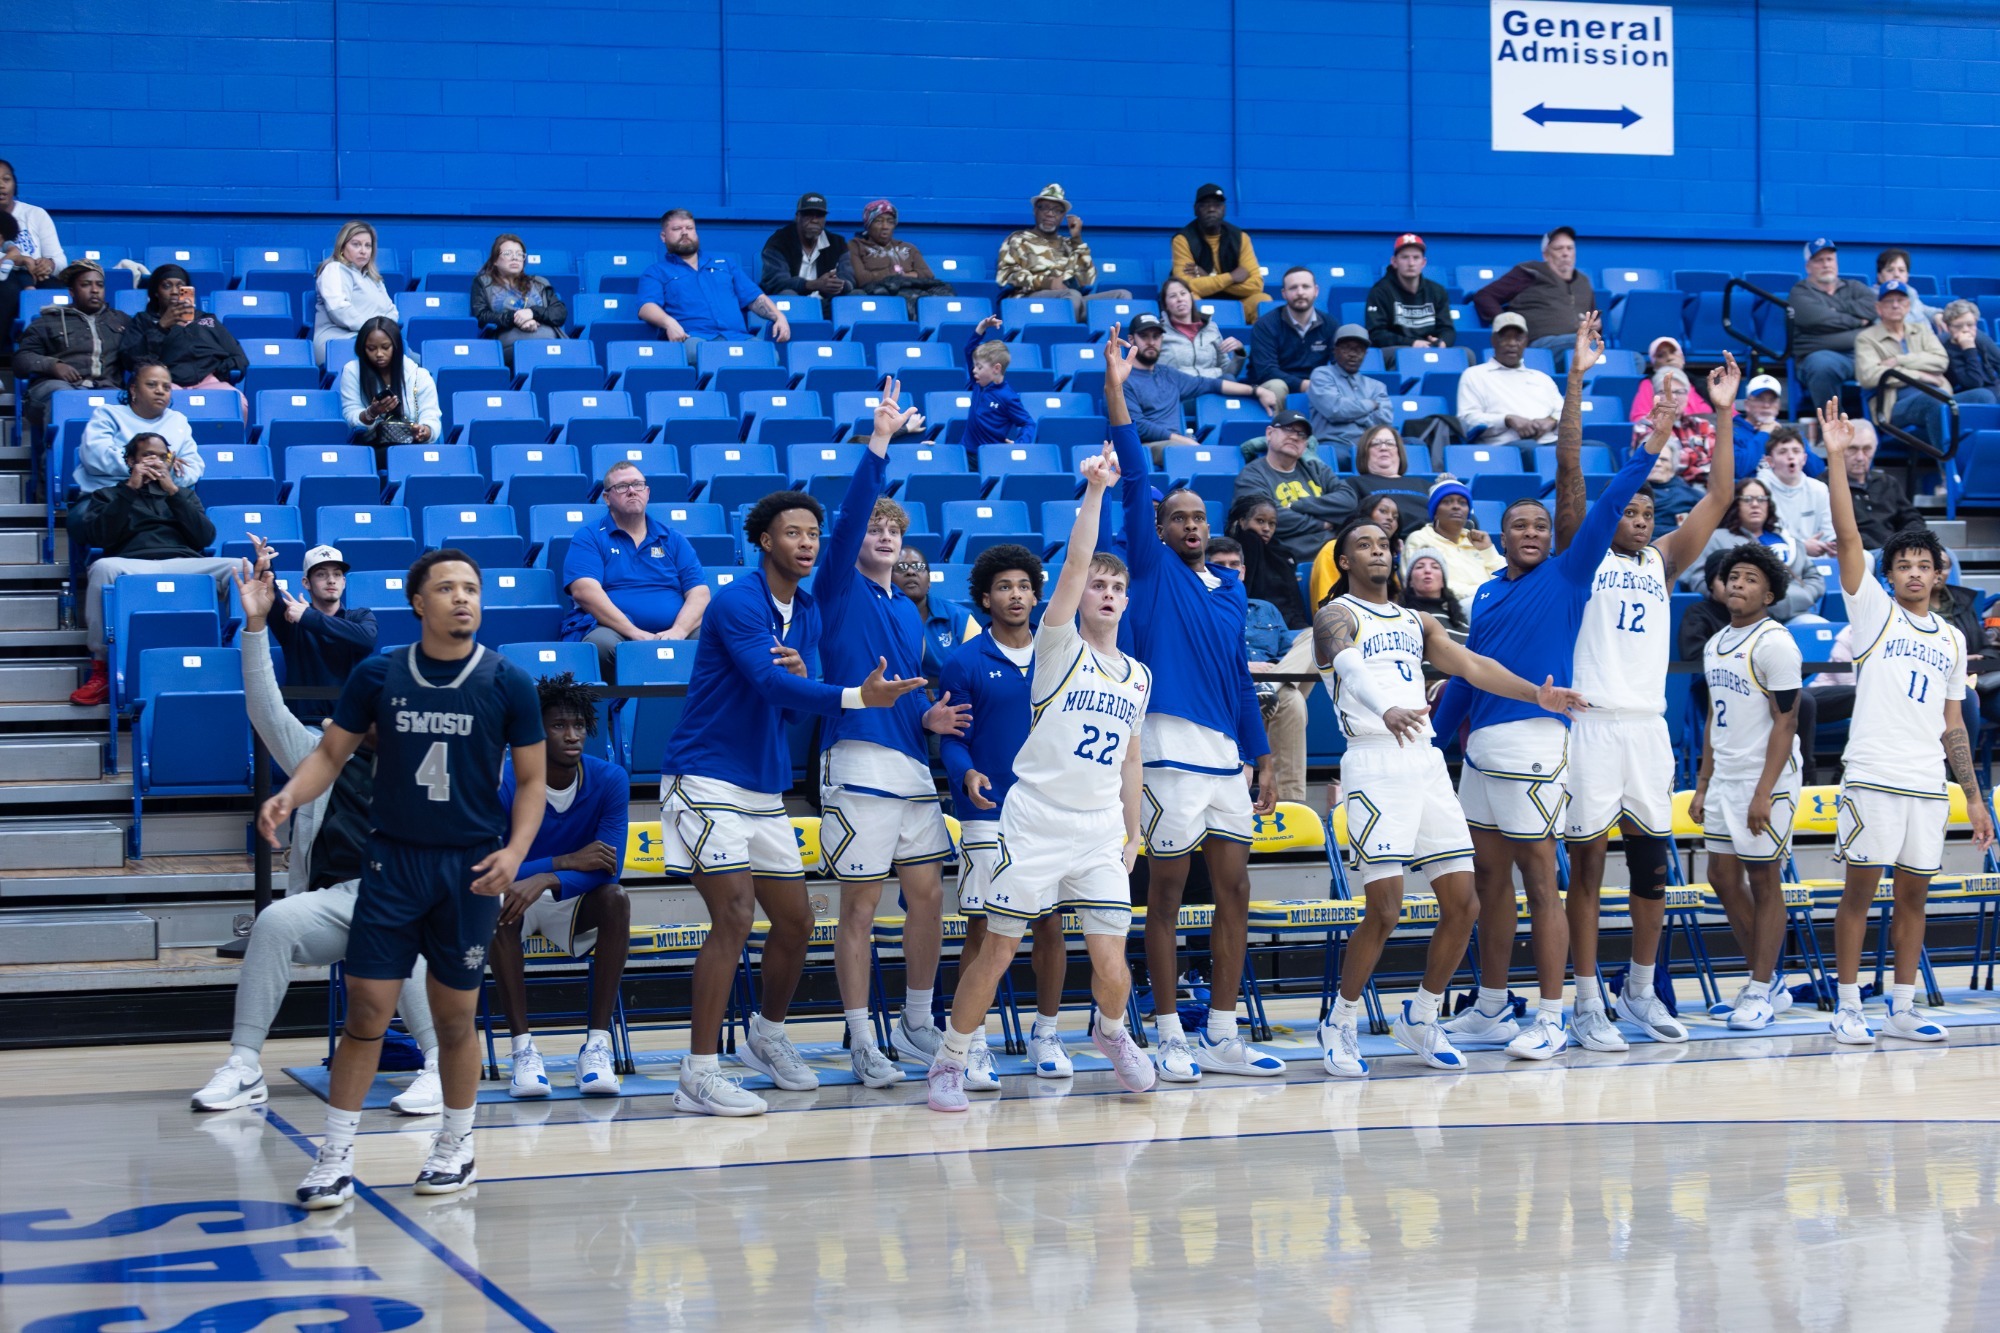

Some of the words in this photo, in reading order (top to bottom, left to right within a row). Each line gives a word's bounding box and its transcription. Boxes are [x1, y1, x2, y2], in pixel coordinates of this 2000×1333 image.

[1502, 10, 1662, 42] General
[1497, 39, 1668, 68] Admission
[1616, 600, 1645, 633] 12
[1907, 670, 1929, 704] 11
[395, 710, 474, 736] SWOSU
[1715, 699, 1728, 727] 2
[1073, 723, 1120, 766] 22
[414, 741, 450, 802] 4
[1290, 906, 1358, 924] MULERIDERS
